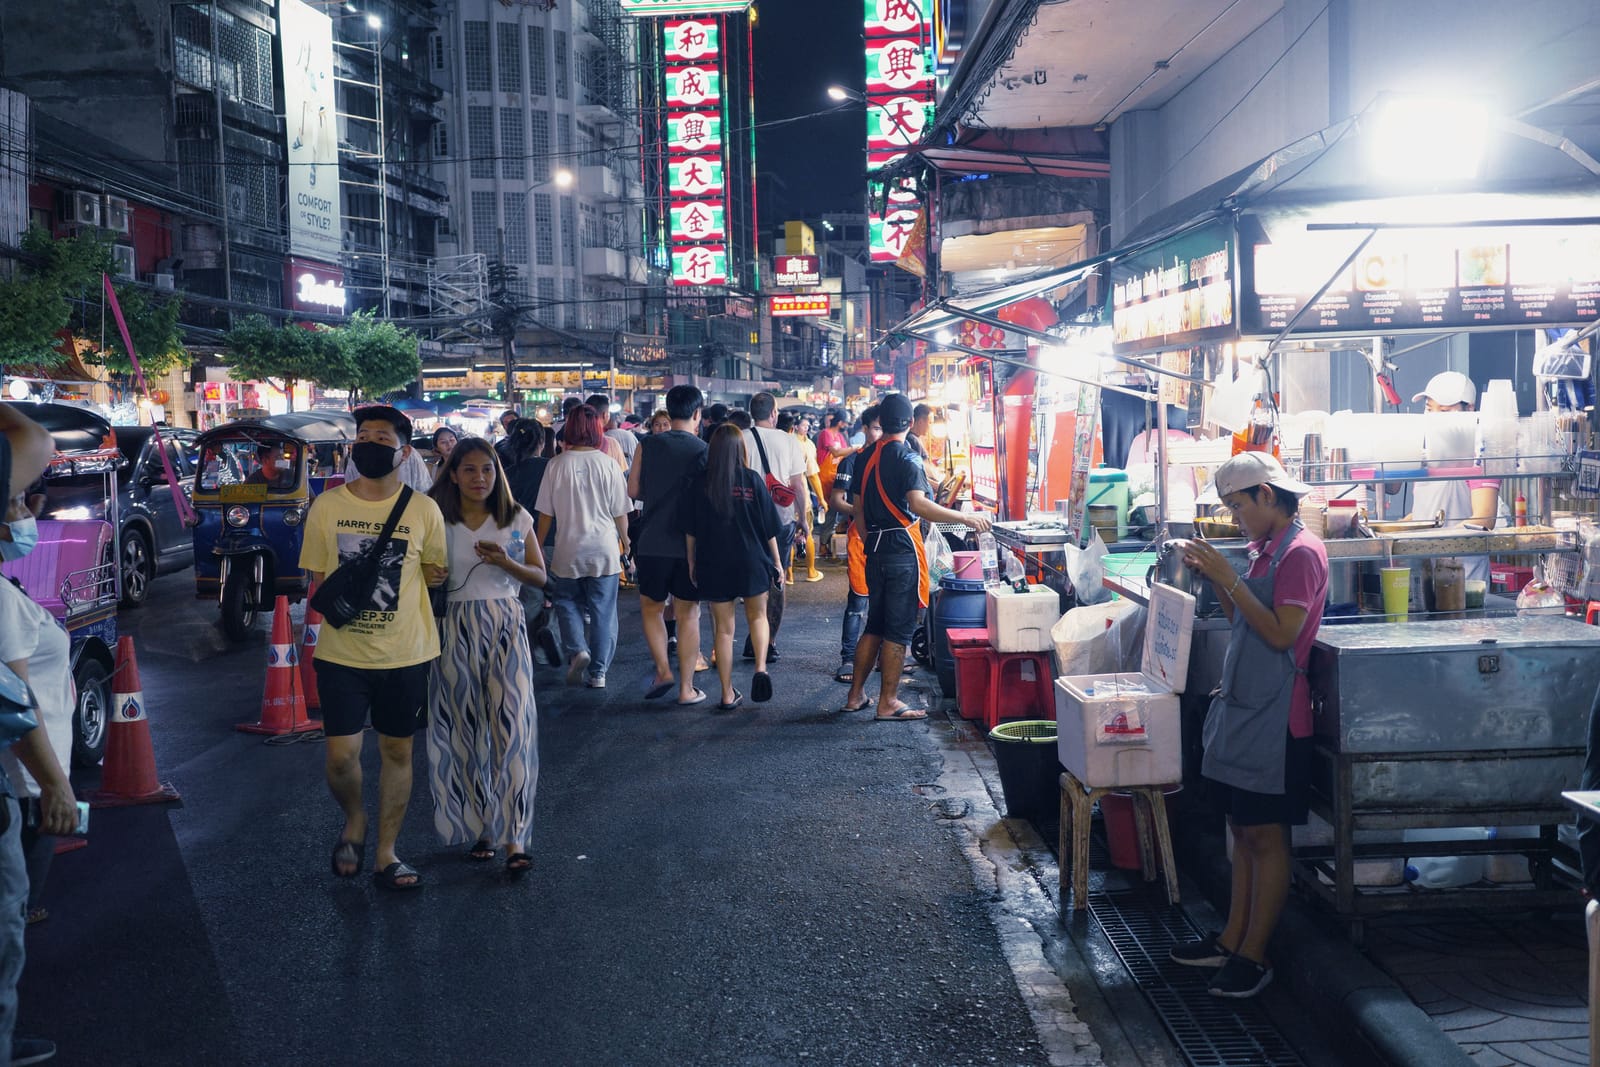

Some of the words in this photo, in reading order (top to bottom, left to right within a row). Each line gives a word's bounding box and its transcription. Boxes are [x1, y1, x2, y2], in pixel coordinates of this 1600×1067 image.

[883, 0, 918, 250] 成興大行
[678, 26, 711, 279] 和成興大金行
[297, 192, 332, 213] COMFORT
[307, 212, 331, 230] STYLE?
[777, 272, 796, 281] Hotel
[798, 272, 819, 281] Royal
[337, 519, 372, 530] HARRY
[374, 522, 410, 534] STES
[358, 622, 386, 630] THEATRE
